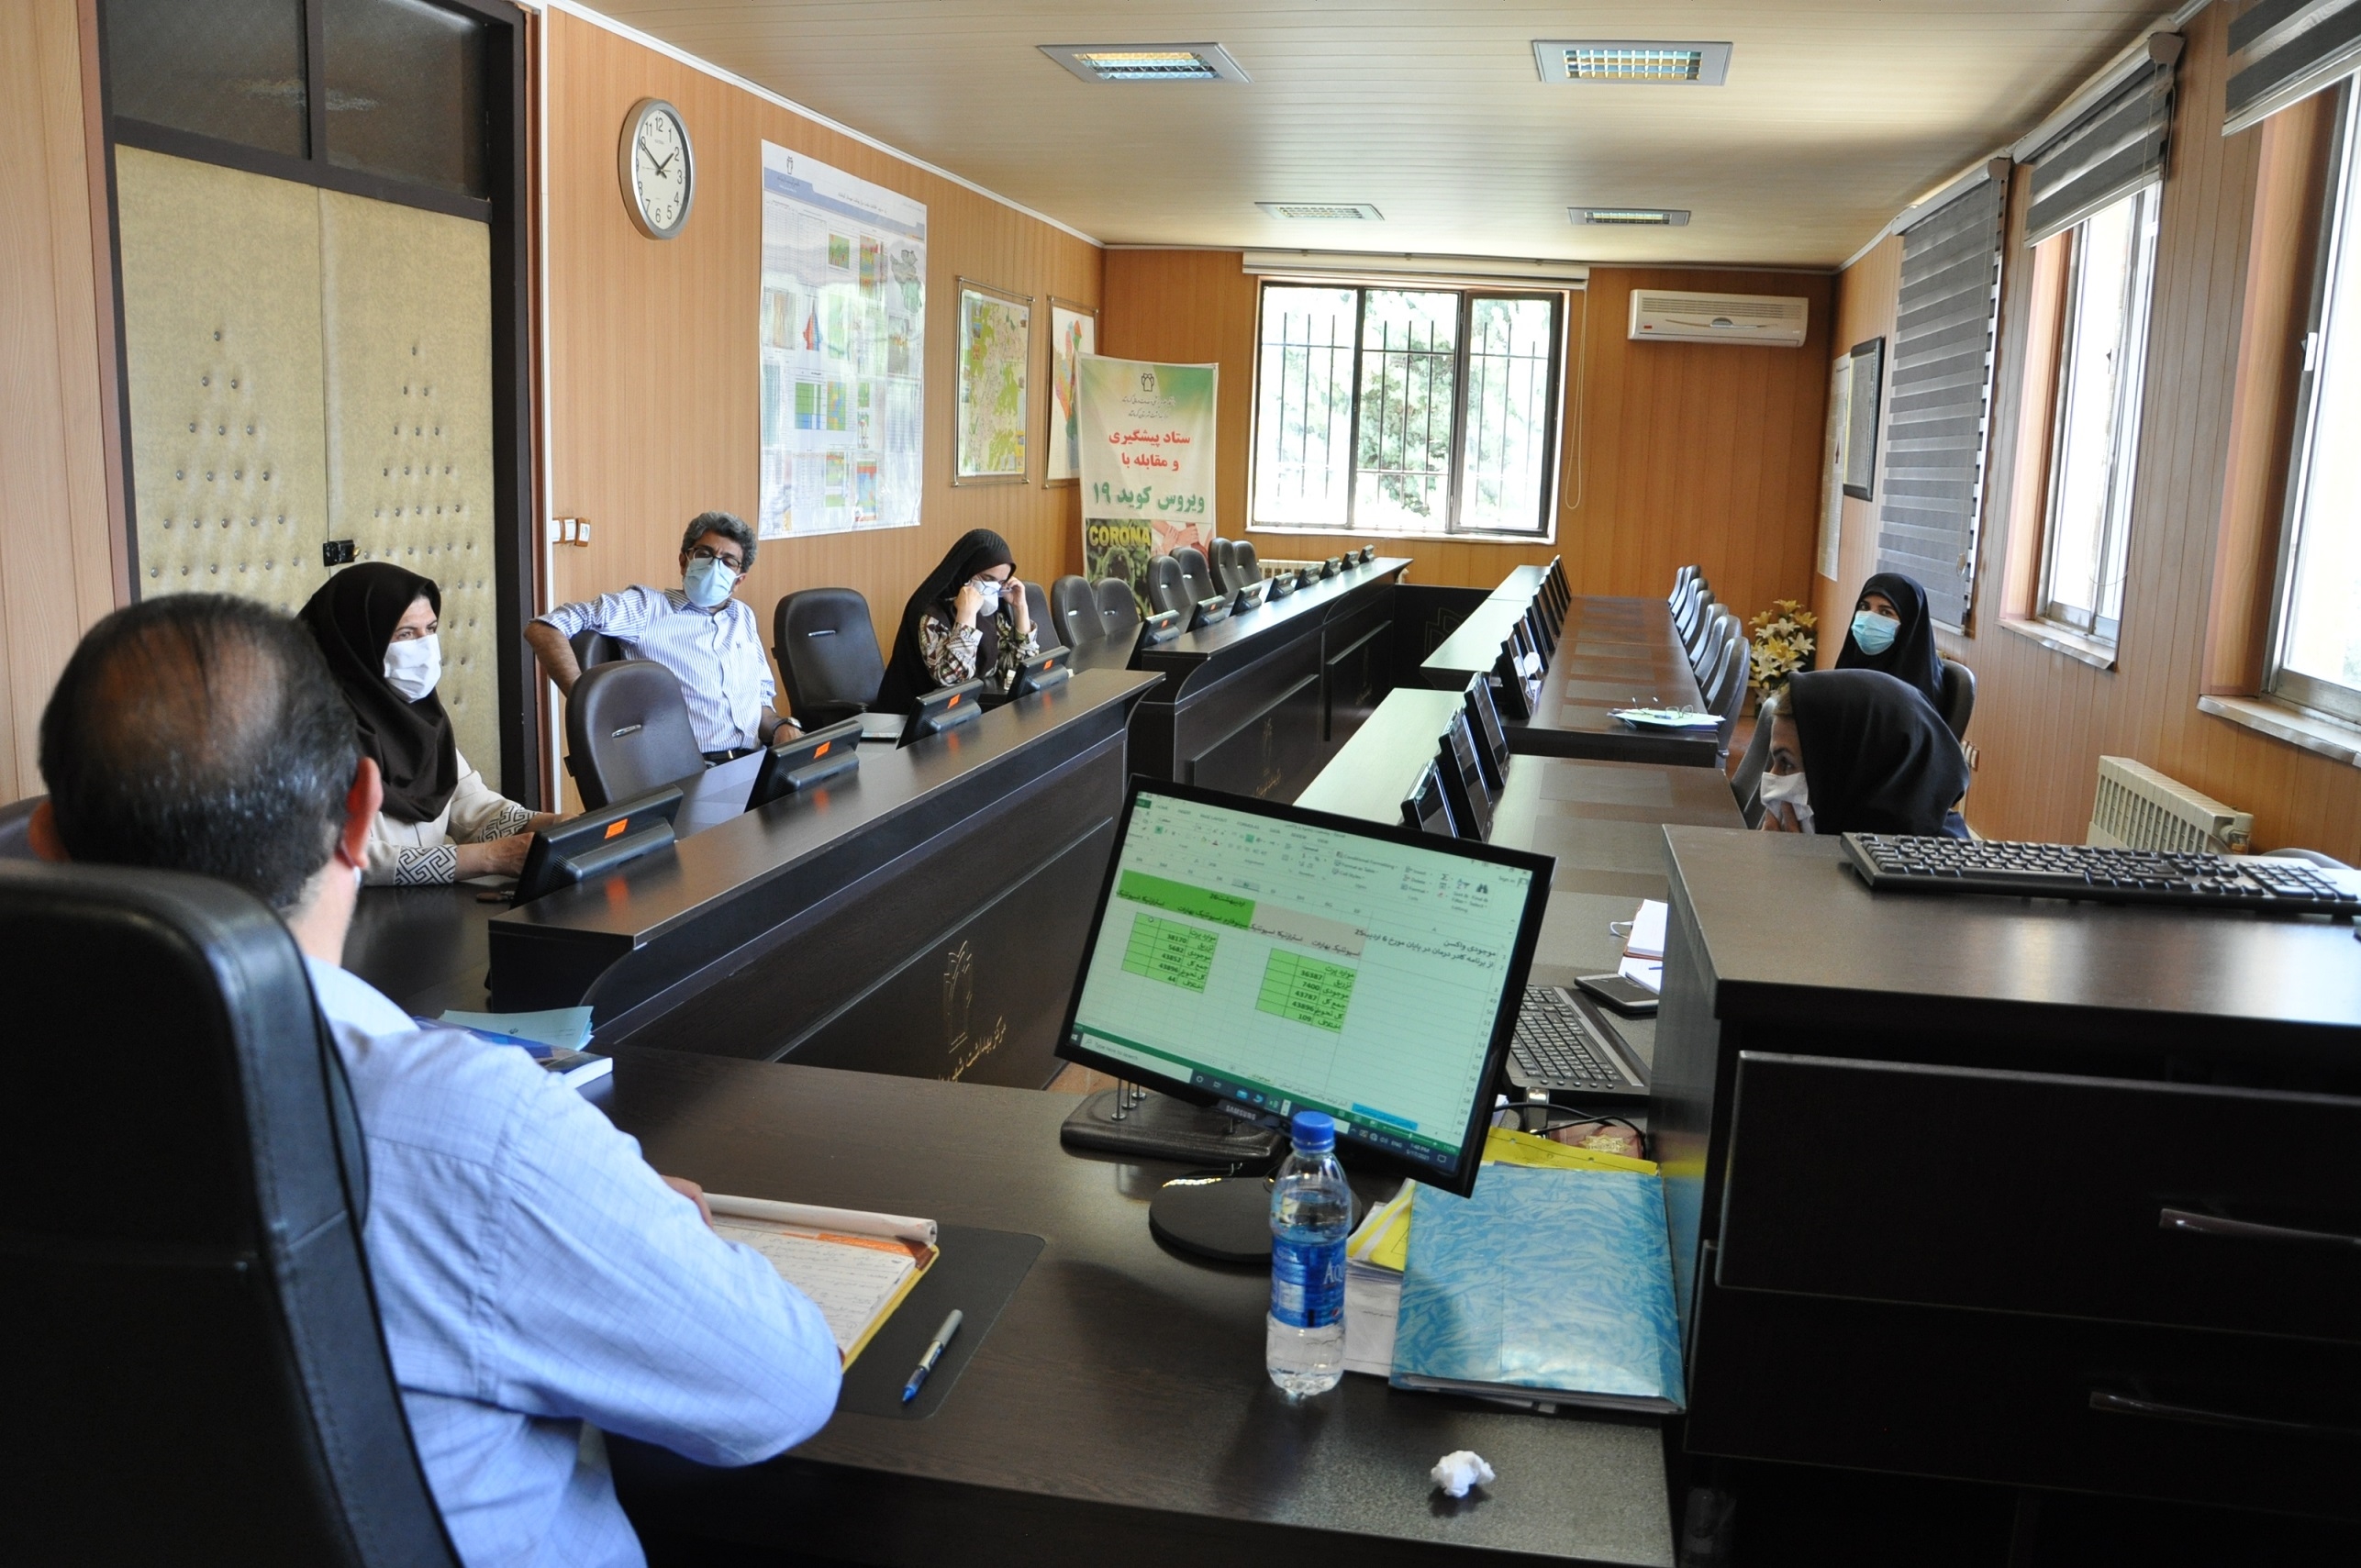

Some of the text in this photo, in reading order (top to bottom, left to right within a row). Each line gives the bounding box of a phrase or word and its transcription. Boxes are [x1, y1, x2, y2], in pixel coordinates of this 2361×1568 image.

[645, 121, 652, 137] 11
[655, 117, 663, 132] 12
[668, 128, 673, 143] 1
[674, 147, 680, 161] 2
[677, 170, 683, 184] 3
[674, 192, 680, 206] 4
[645, 198, 651, 214] 7
[655, 208, 661, 223] 6
[666, 206, 673, 220] 5
[1108, 428, 1190, 447] ستاد پیشگیری
[1121, 452, 1179, 471] و مقابله با
[1093, 482, 1205, 514] ویروس کوید ۱۹
[1088, 525, 1152, 547] CORONA
[1166, 933, 1187, 944] 38170
[1201, 932, 1217, 943] موارد
[1387, 936, 1406, 948] مورخ
[1167, 943, 1184, 953] 5682
[1405, 940, 1422, 951] پایان
[1442, 937, 1497, 958] موجودی واکسن
[1161, 952, 1181, 963] 43852
[1186, 950, 1211, 962] موجودی
[1431, 947, 1451, 959] درمان
[1451, 951, 1466, 962] کادر
[1157, 962, 1179, 973] 43896
[1186, 959, 1208, 973] جمع کل
[1464, 955, 1487, 968] برنامه
[1166, 974, 1175, 983] 44
[1197, 972, 1207, 982] کل
[1300, 969, 1322, 981] 36387
[1337, 968, 1354, 980] موارد
[1182, 978, 1204, 990] اختلاف
[1302, 981, 1320, 991] 7400
[1332, 977, 1352, 991] تزریق
[1294, 989, 1317, 1001] 43787
[1322, 986, 1349, 1001] موجودی
[1291, 1000, 1315, 1012] 43896
[1321, 996, 1345, 1012] جمع کل
[1297, 1013, 1312, 1022] 109
[1333, 1011, 1343, 1021] کل
[1317, 1017, 1341, 1030] اختلاف
[1226, 1105, 1256, 1120] SAMSUNG
